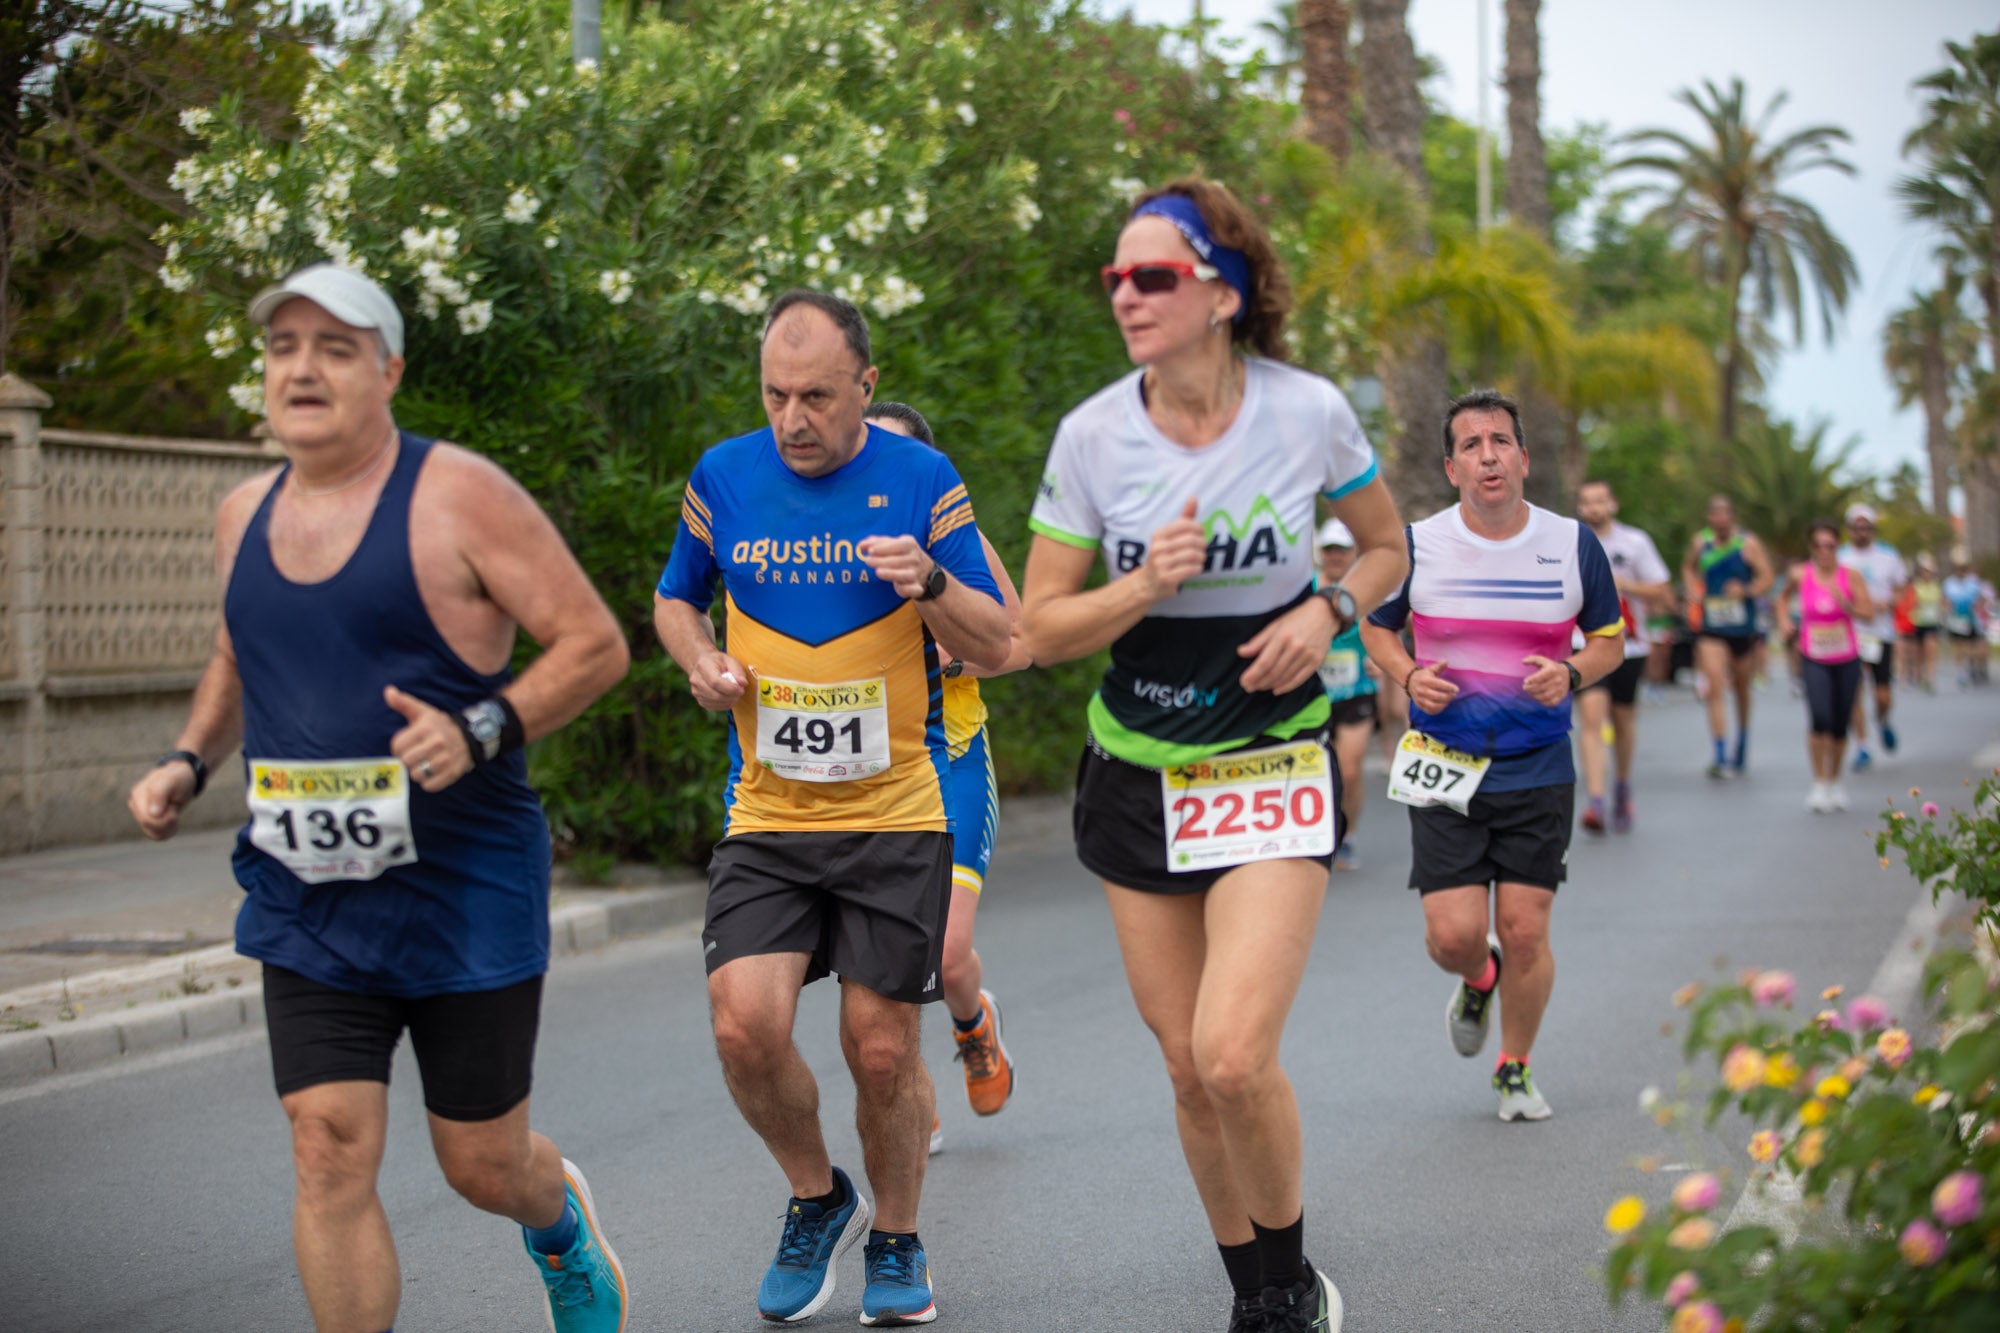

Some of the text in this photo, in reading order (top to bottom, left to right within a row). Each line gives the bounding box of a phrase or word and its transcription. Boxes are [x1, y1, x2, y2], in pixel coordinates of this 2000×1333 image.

[755, 569, 869, 584] GRANADA
[772, 685, 792, 703] 38
[774, 716, 862, 755] 491
[1188, 762, 1211, 779] 38
[1402, 759, 1466, 792] 497
[276, 808, 381, 851] 136
[1172, 786, 1324, 841] 2250
